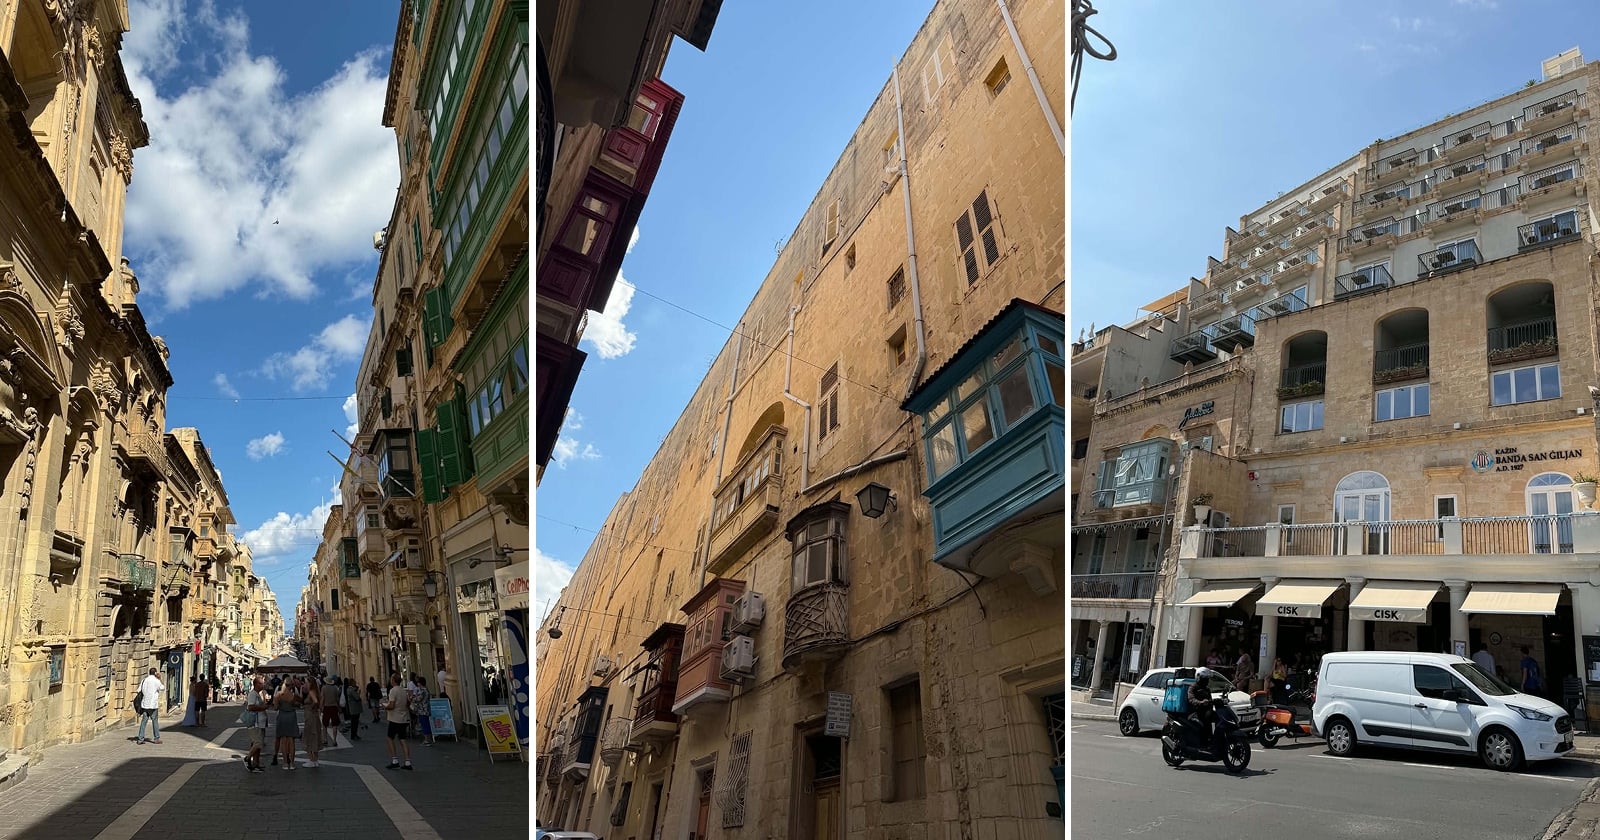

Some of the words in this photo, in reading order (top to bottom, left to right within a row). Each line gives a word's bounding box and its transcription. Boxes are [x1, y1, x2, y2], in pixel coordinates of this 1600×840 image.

[1496, 447, 1518, 455] KAŽIN
[1495, 454, 1527, 464] BANDA
[1528, 452, 1547, 462] SAN
[1549, 449, 1582, 460] ĠILJAN
[1277, 606, 1299, 616] CISK
[1373, 609, 1400, 620] CISK
